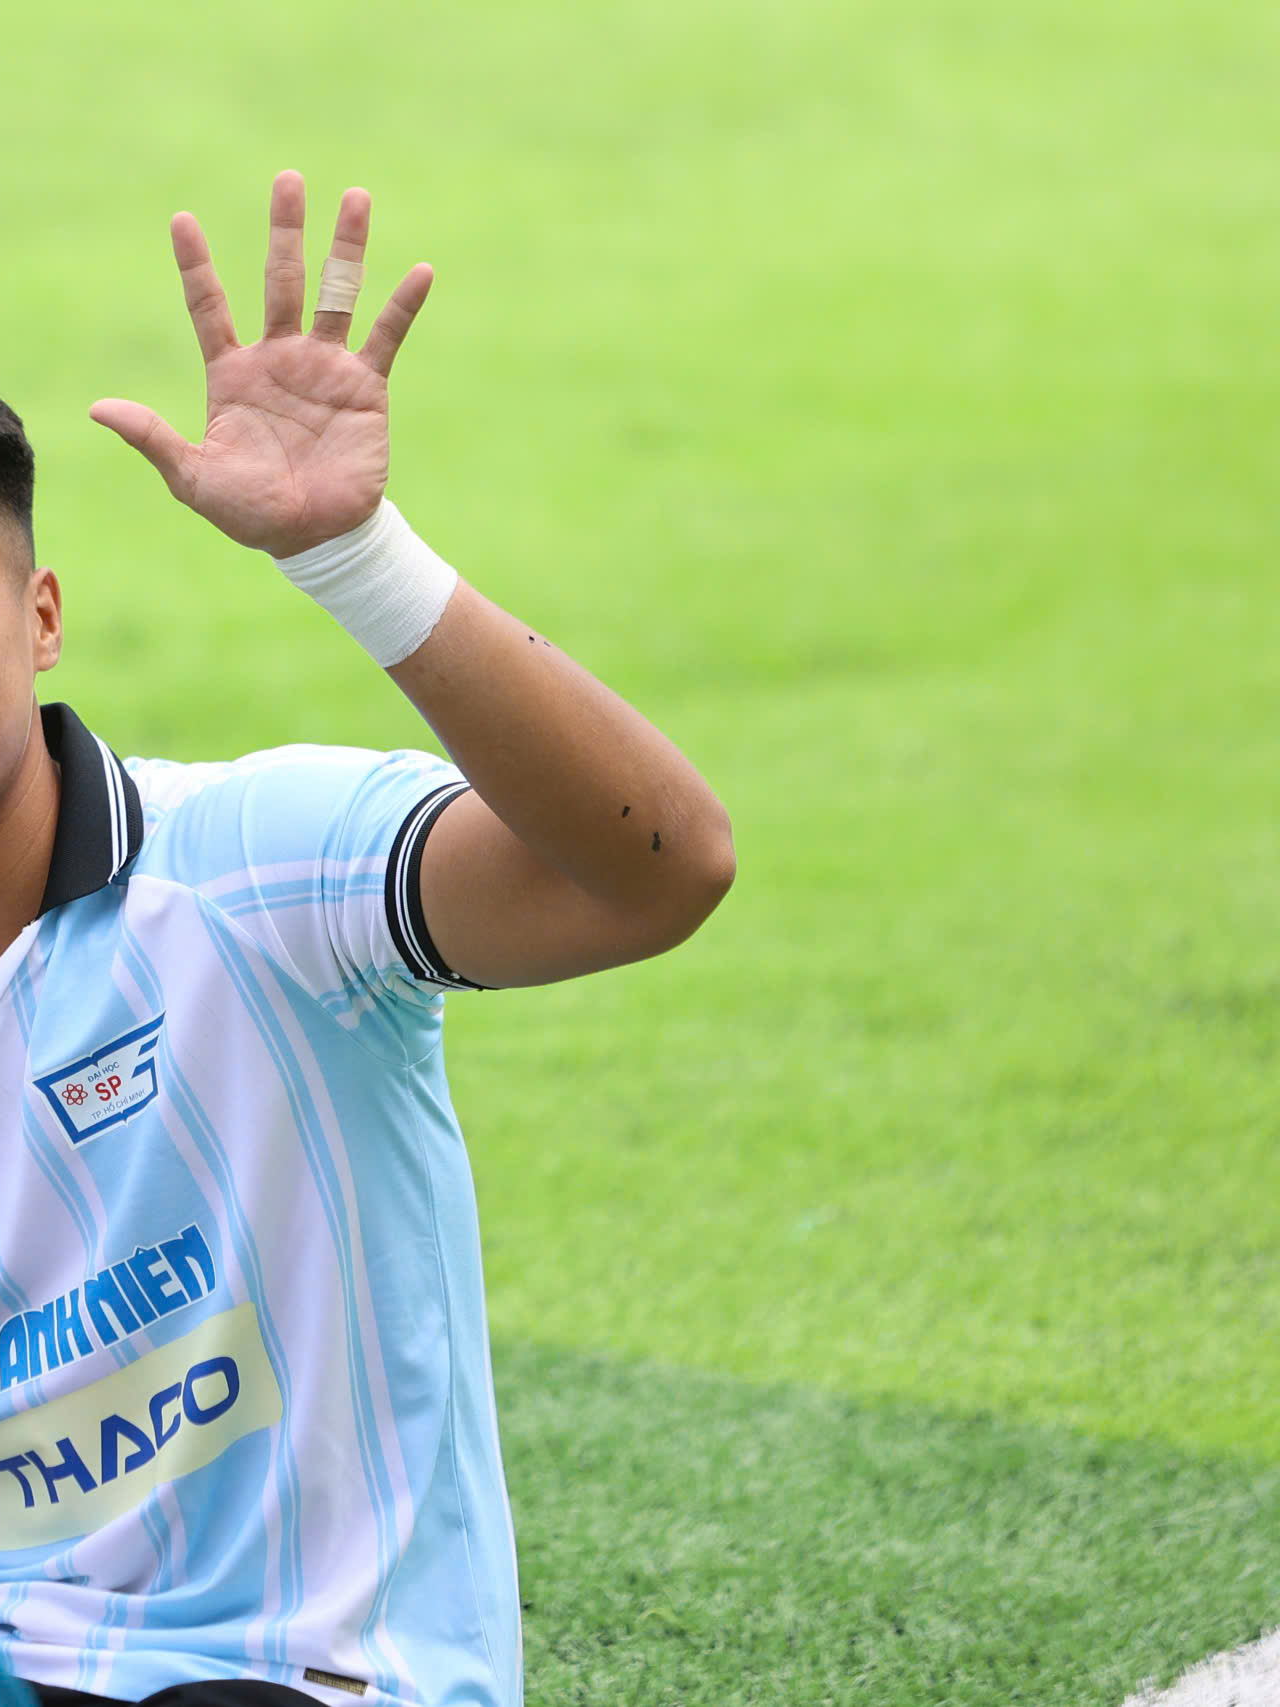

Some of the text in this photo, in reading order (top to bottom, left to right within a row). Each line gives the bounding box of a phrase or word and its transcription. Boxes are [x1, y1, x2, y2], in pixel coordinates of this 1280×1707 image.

[88, 1061, 120, 1083] ĐẠI HỌC
[95, 1075, 122, 1101] SP
